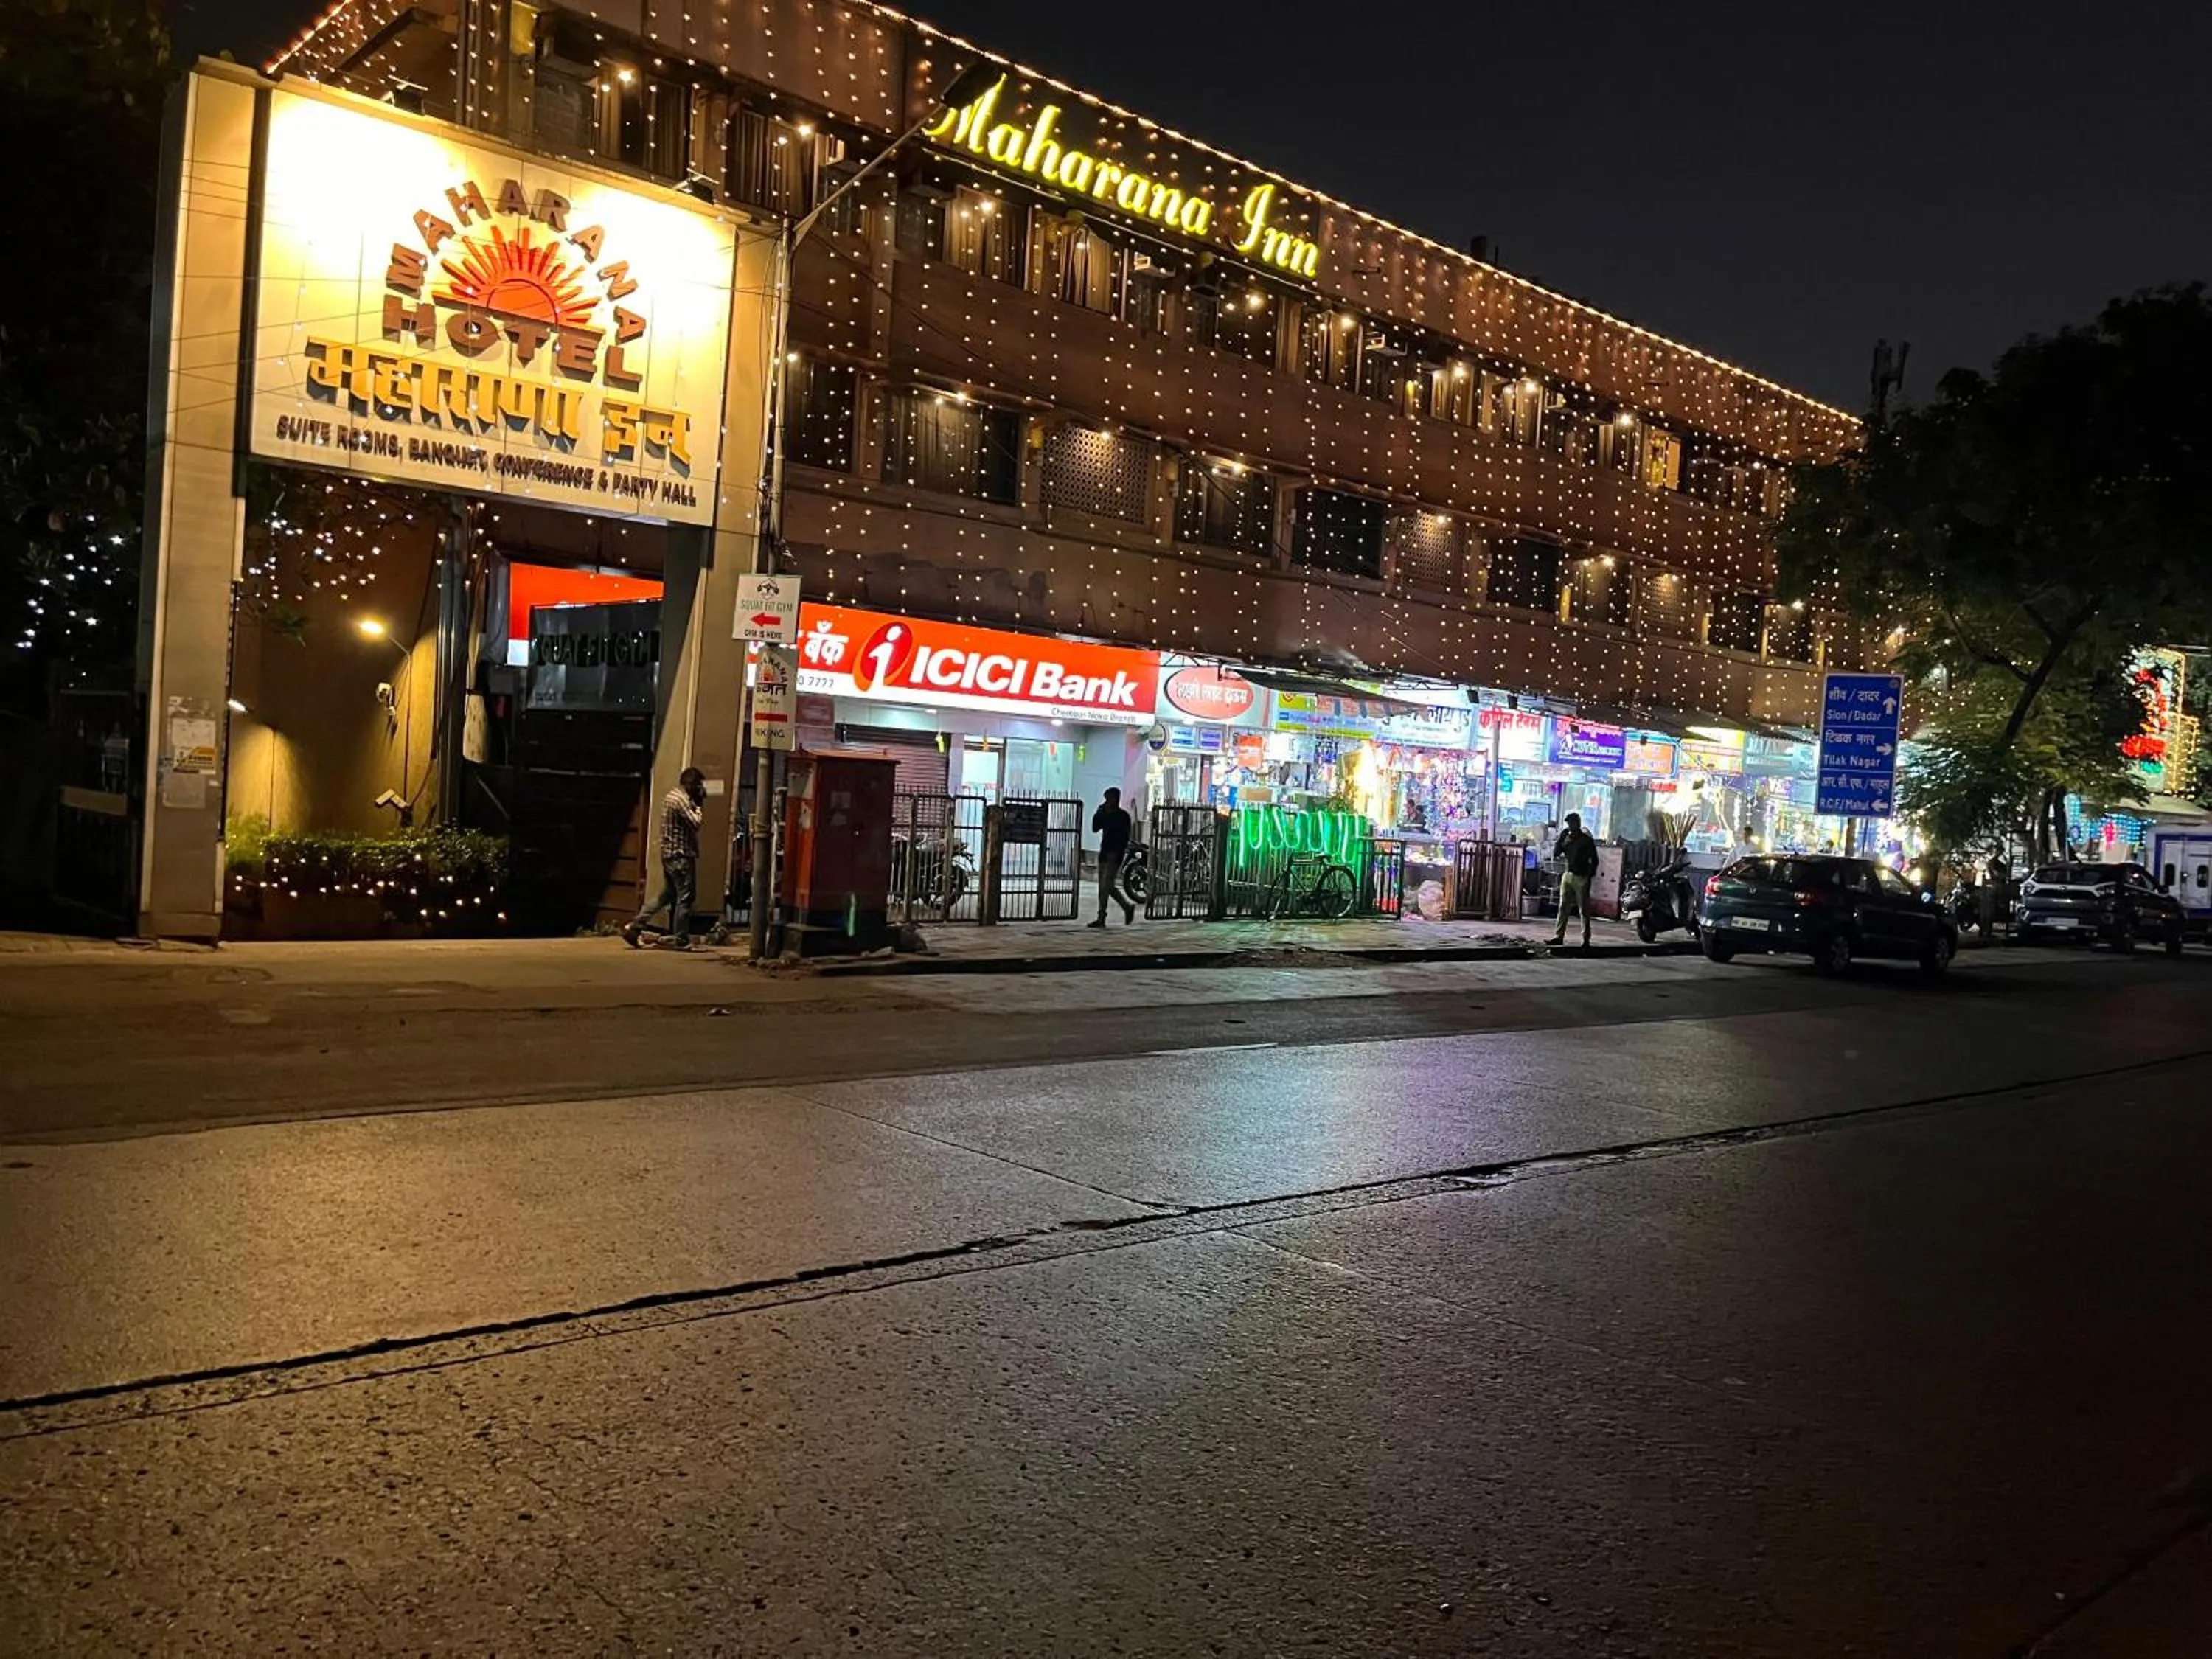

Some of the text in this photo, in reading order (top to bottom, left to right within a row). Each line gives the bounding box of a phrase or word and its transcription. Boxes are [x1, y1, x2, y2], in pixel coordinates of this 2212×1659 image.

[922, 73, 1319, 278] Maharana Inn
[385, 179, 647, 344] MAHARANA
[382, 293, 642, 392] HOTEL
[305, 335, 692, 472] महाराणा इन
[276, 415, 331, 446] SUITE
[337, 425, 403, 464] ROOMS,
[493, 452, 594, 490] CONFERENCE
[597, 470, 608, 493] &
[613, 472, 658, 501] PARTY
[662, 481, 697, 508] HALL
[741, 599, 763, 610] SQUAT
[776, 602, 793, 613] GYM
[804, 619, 849, 666] बँक
[808, 676, 834, 688] 7777
[910, 647, 1024, 694] ICICI
[1030, 663, 1139, 706] Bank
[1823, 754, 1881, 768] Tilak Nagar
